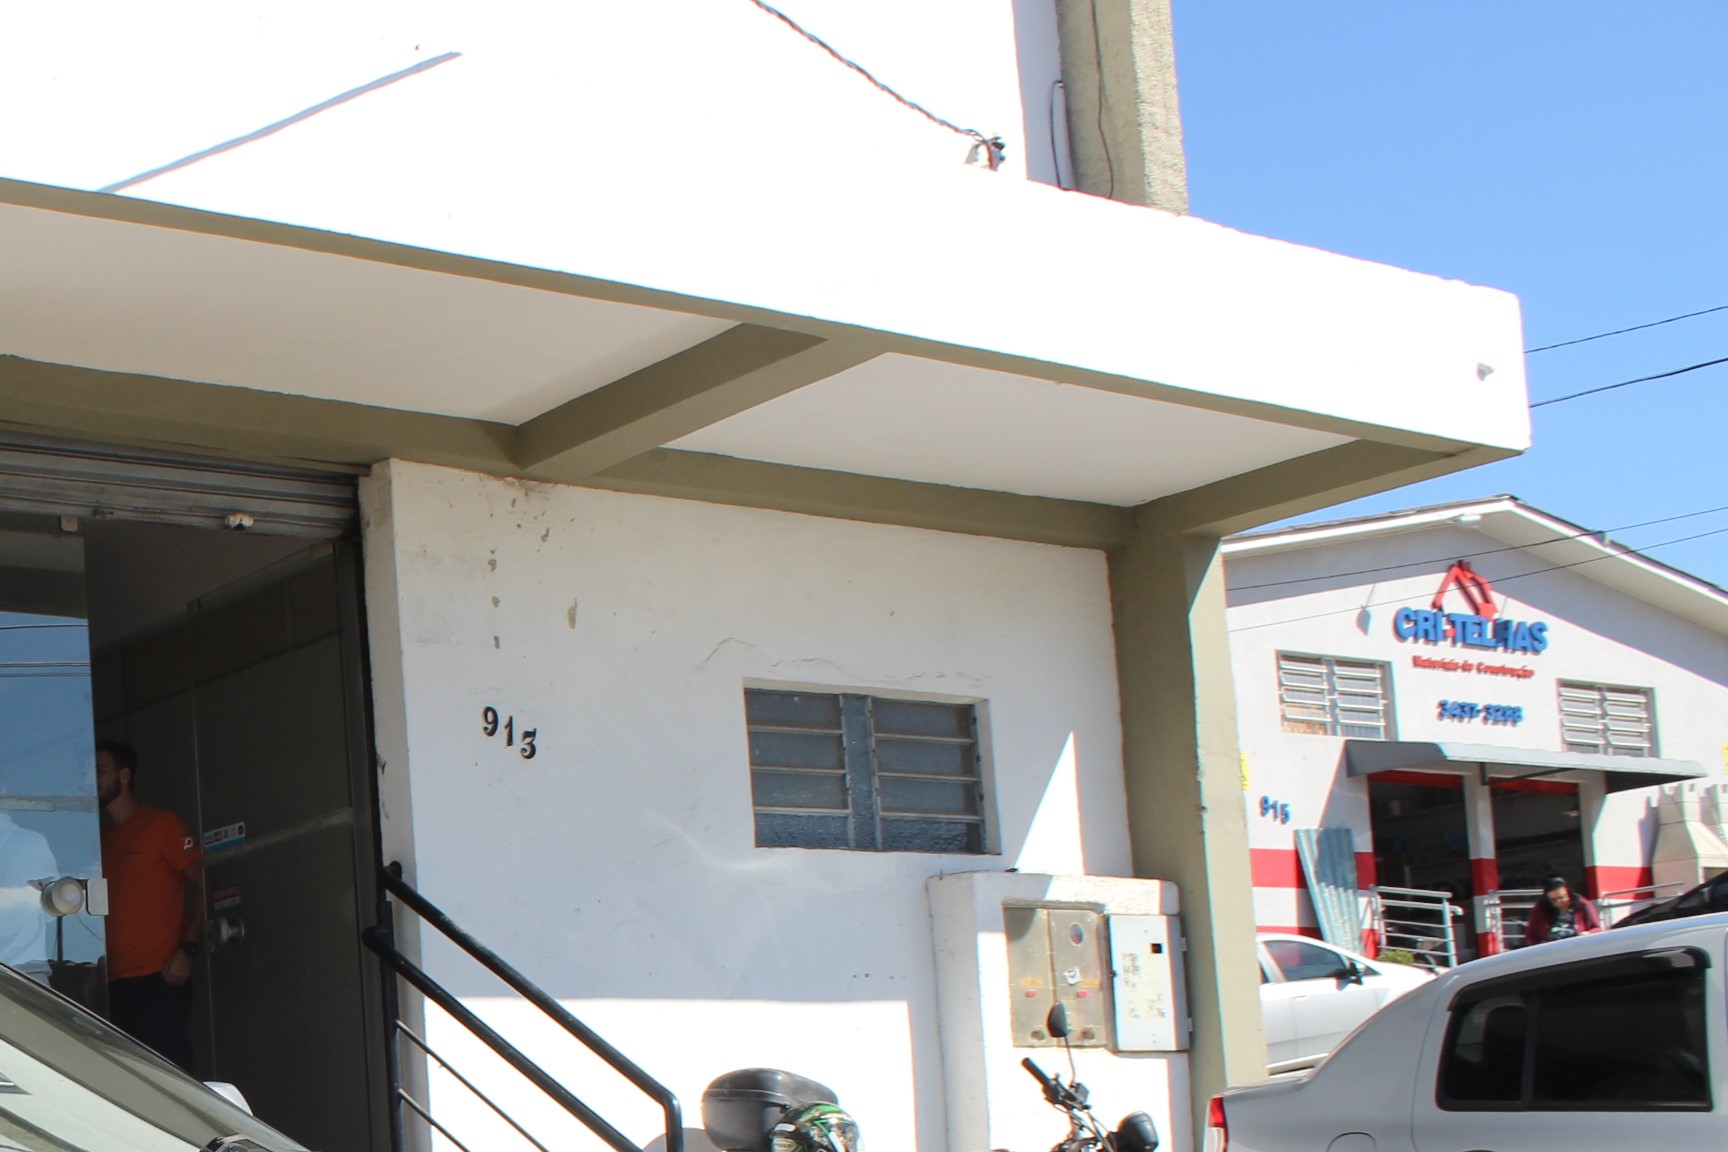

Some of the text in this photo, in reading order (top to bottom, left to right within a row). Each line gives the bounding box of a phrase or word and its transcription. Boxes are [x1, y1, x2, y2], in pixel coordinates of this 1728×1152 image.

[1394, 606, 1549, 654] CRI-TELHAS
[481, 705, 538, 760] 913
[1258, 795, 1291, 825] 915
